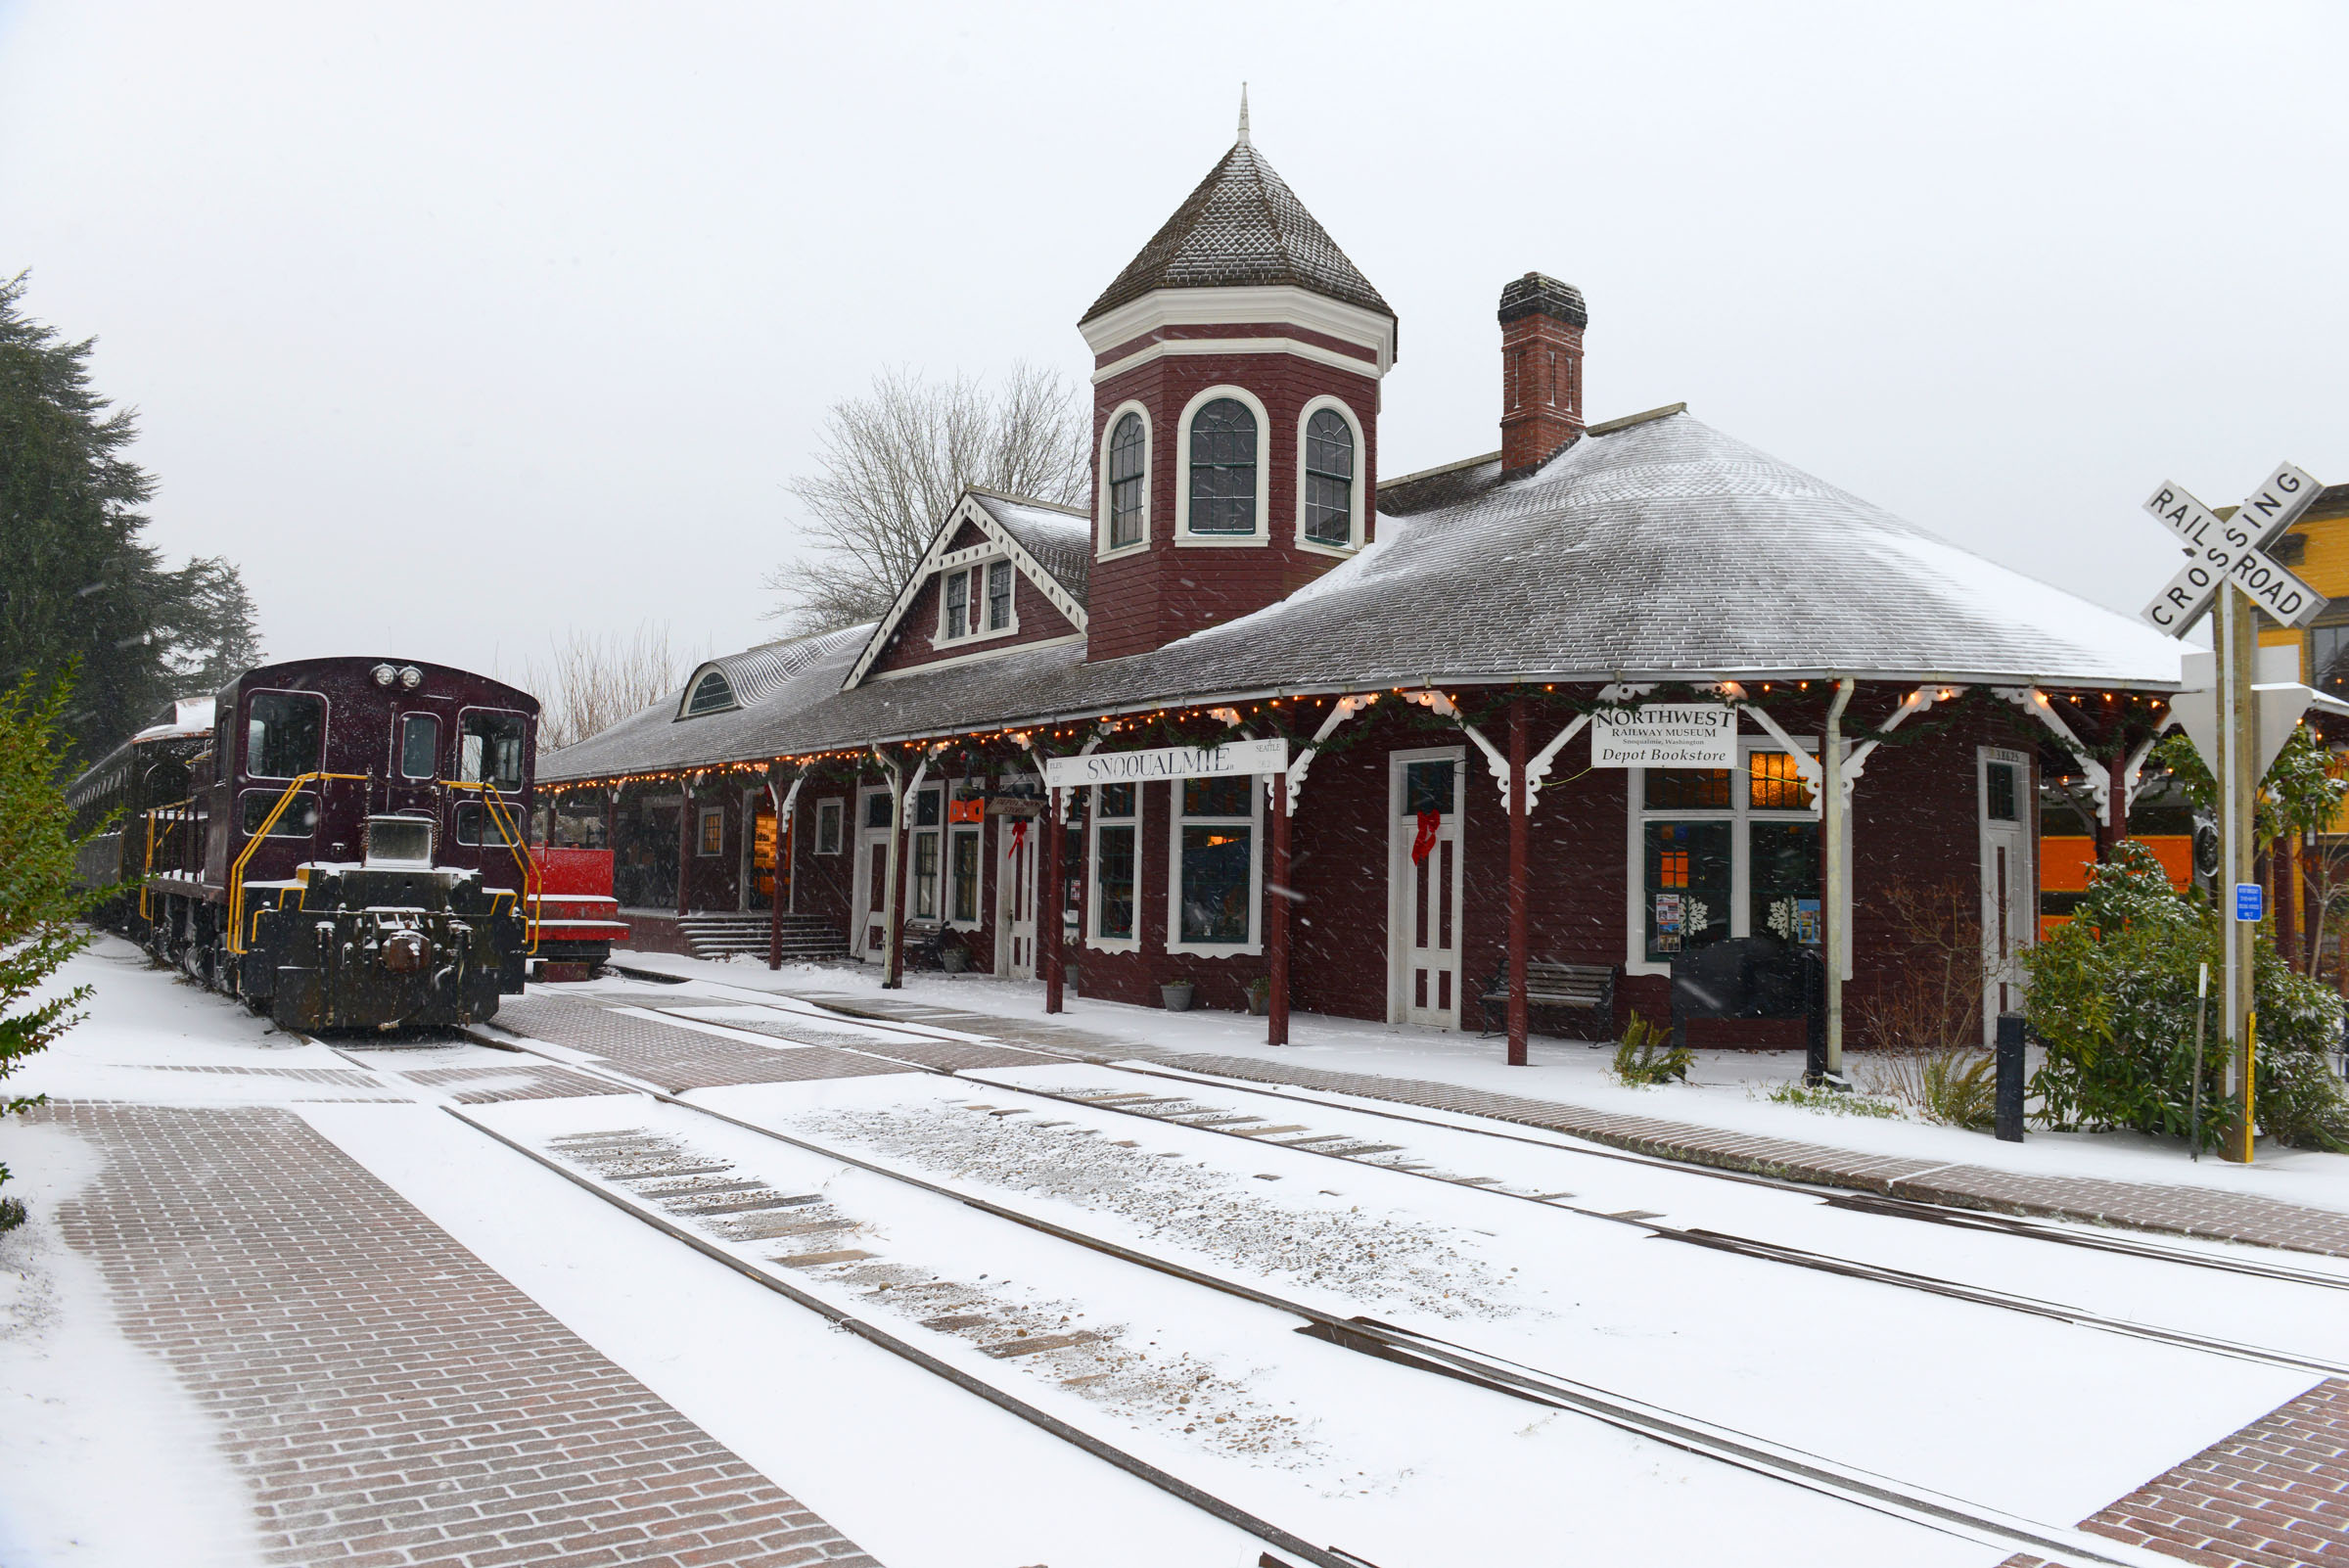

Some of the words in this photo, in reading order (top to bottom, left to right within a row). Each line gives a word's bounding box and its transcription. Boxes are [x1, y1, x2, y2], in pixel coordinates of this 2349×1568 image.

[2150, 488, 2210, 547] RAIL
[2232, 555, 2302, 615] ROAD
[2151, 473, 2300, 625] CROSSING
[1596, 710, 1734, 728] NORTHWEST
[1612, 728, 1663, 737] RAILWAY
[1665, 728, 1717, 737] MUSEUM
[1087, 748, 1230, 780] SNOQUALMIE
[1602, 749, 1646, 763] Depot
[1651, 749, 1727, 761] Bookstore
